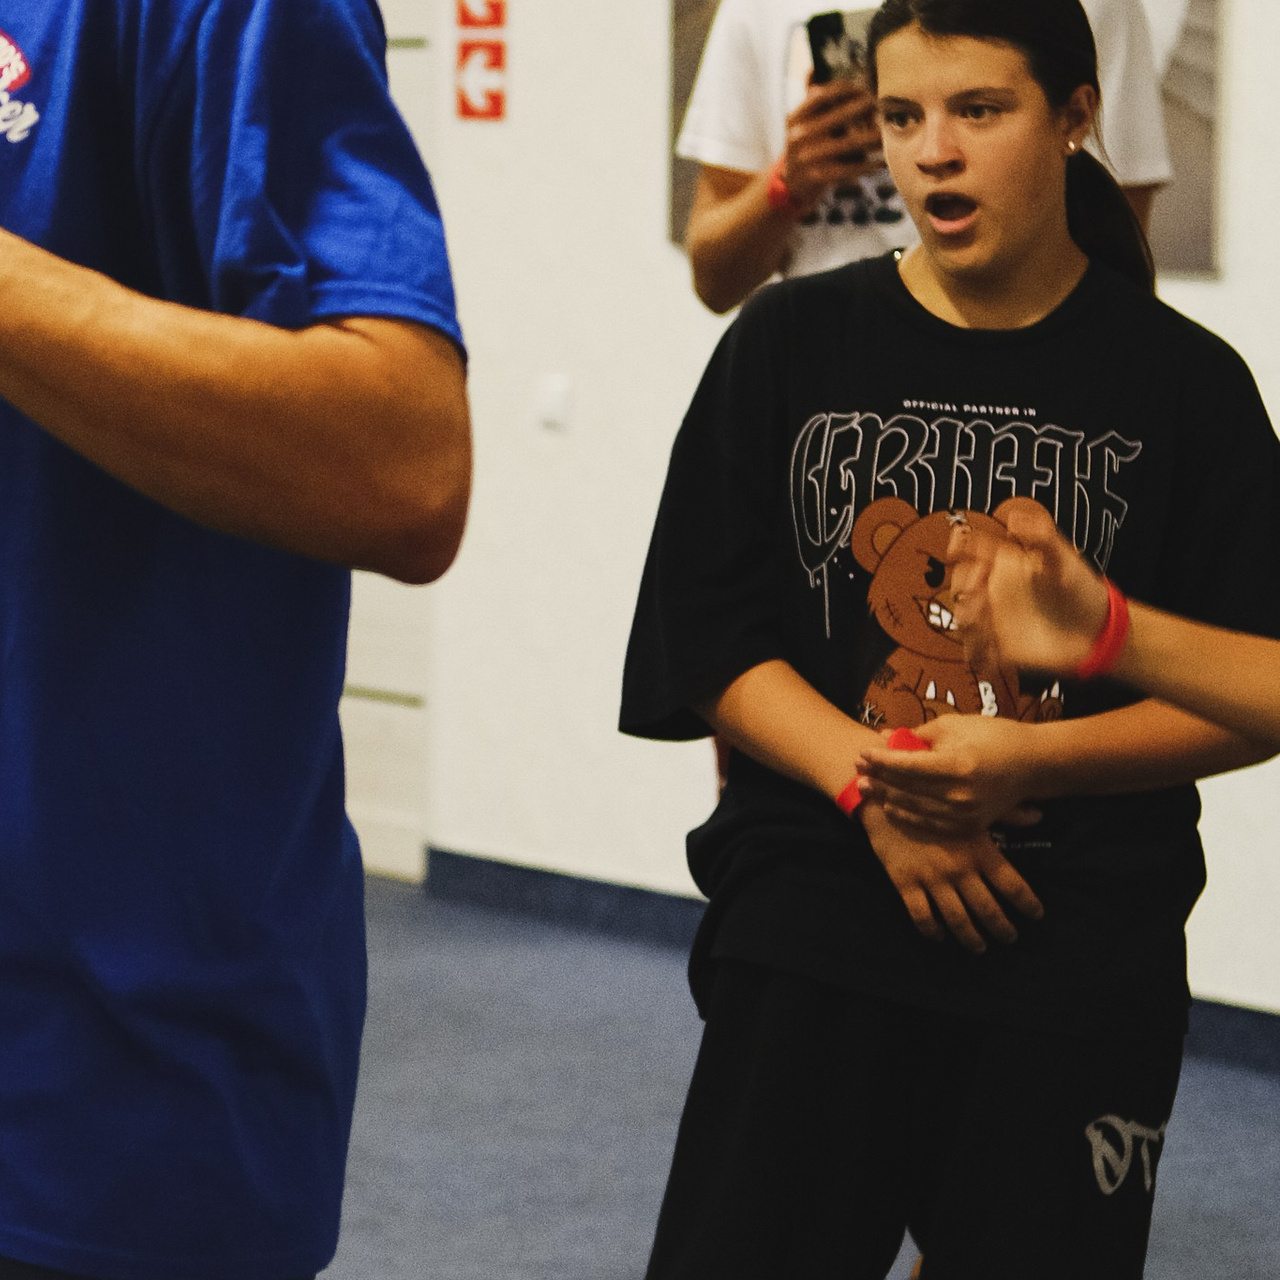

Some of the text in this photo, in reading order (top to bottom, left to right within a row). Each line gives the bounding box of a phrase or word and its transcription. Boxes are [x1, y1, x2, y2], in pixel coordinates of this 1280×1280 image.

[902, 398, 1037, 418] OFFICIAL PARTNER IN
